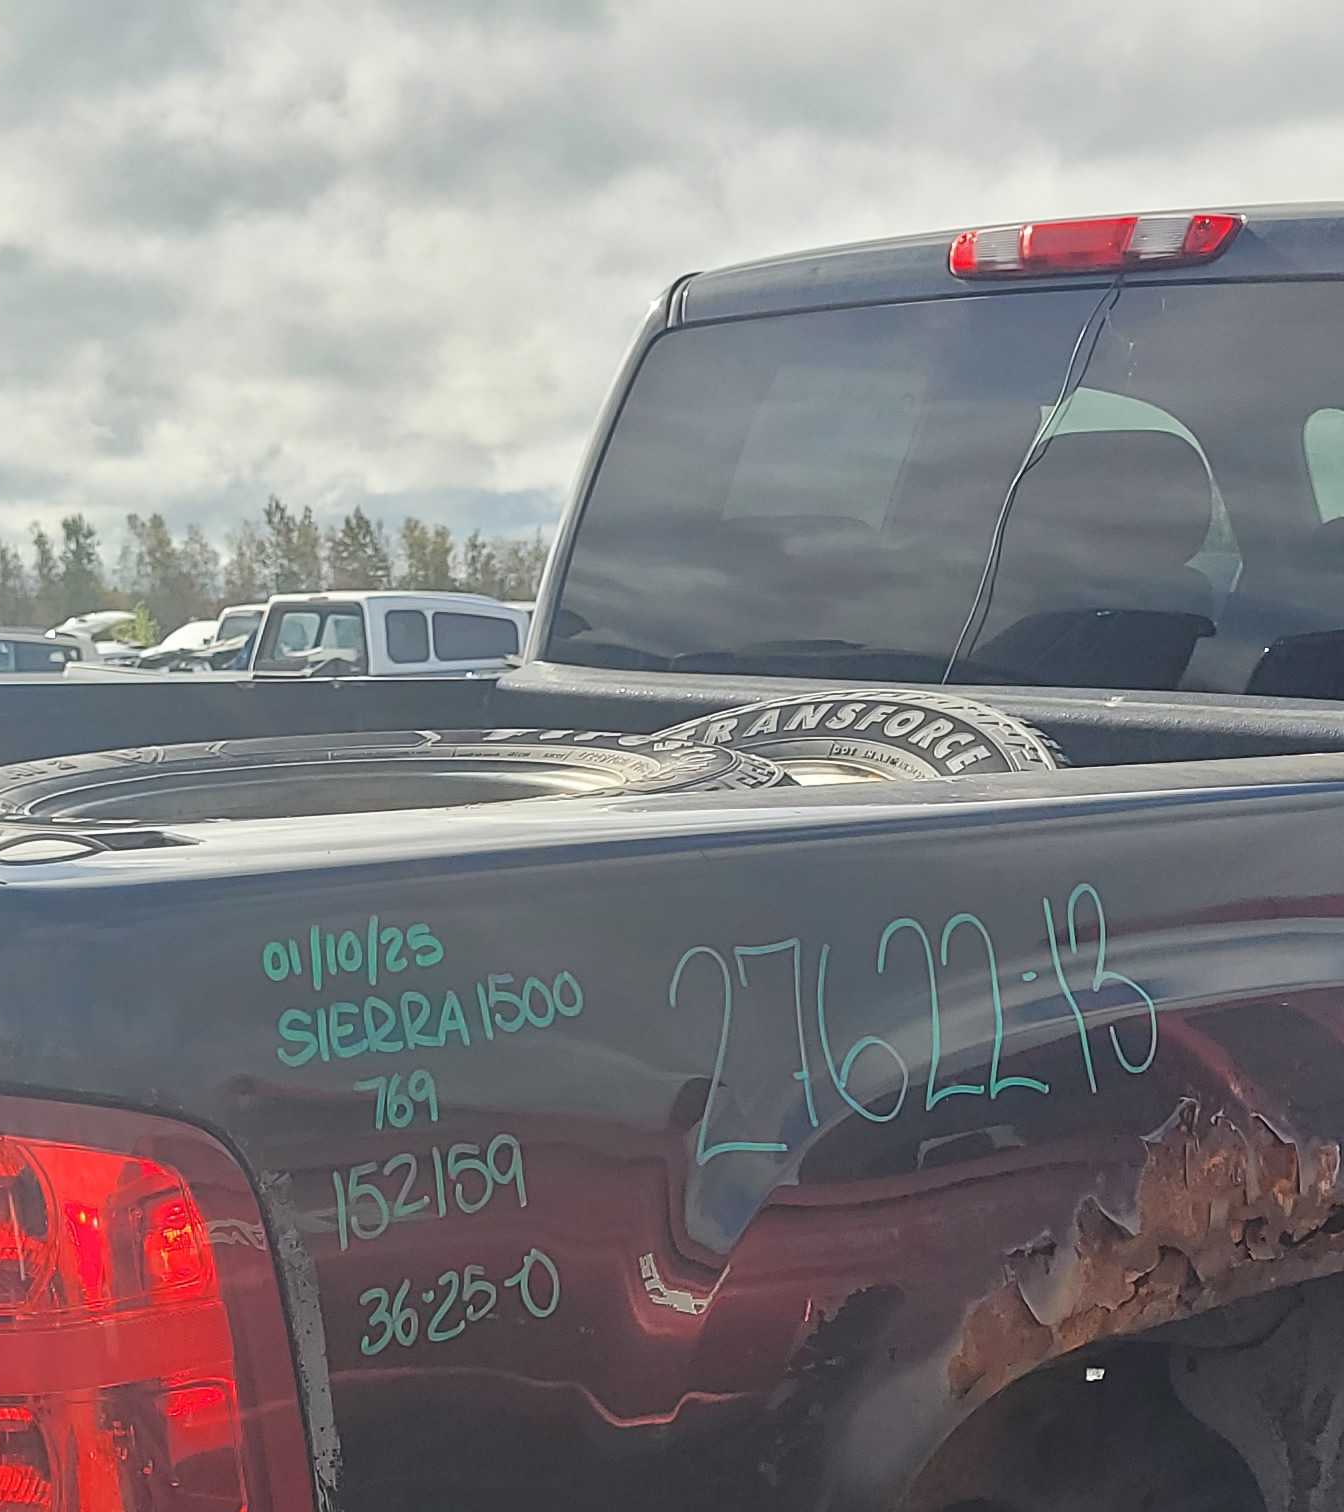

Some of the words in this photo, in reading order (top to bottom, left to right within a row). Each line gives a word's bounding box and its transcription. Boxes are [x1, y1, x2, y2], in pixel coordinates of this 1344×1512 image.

[261, 914, 446, 991] 01/10/25
[276, 989, 471, 1068] SIERRA
[353, 1068, 441, 1131] 769
[332, 1133, 528, 1252] 152159
